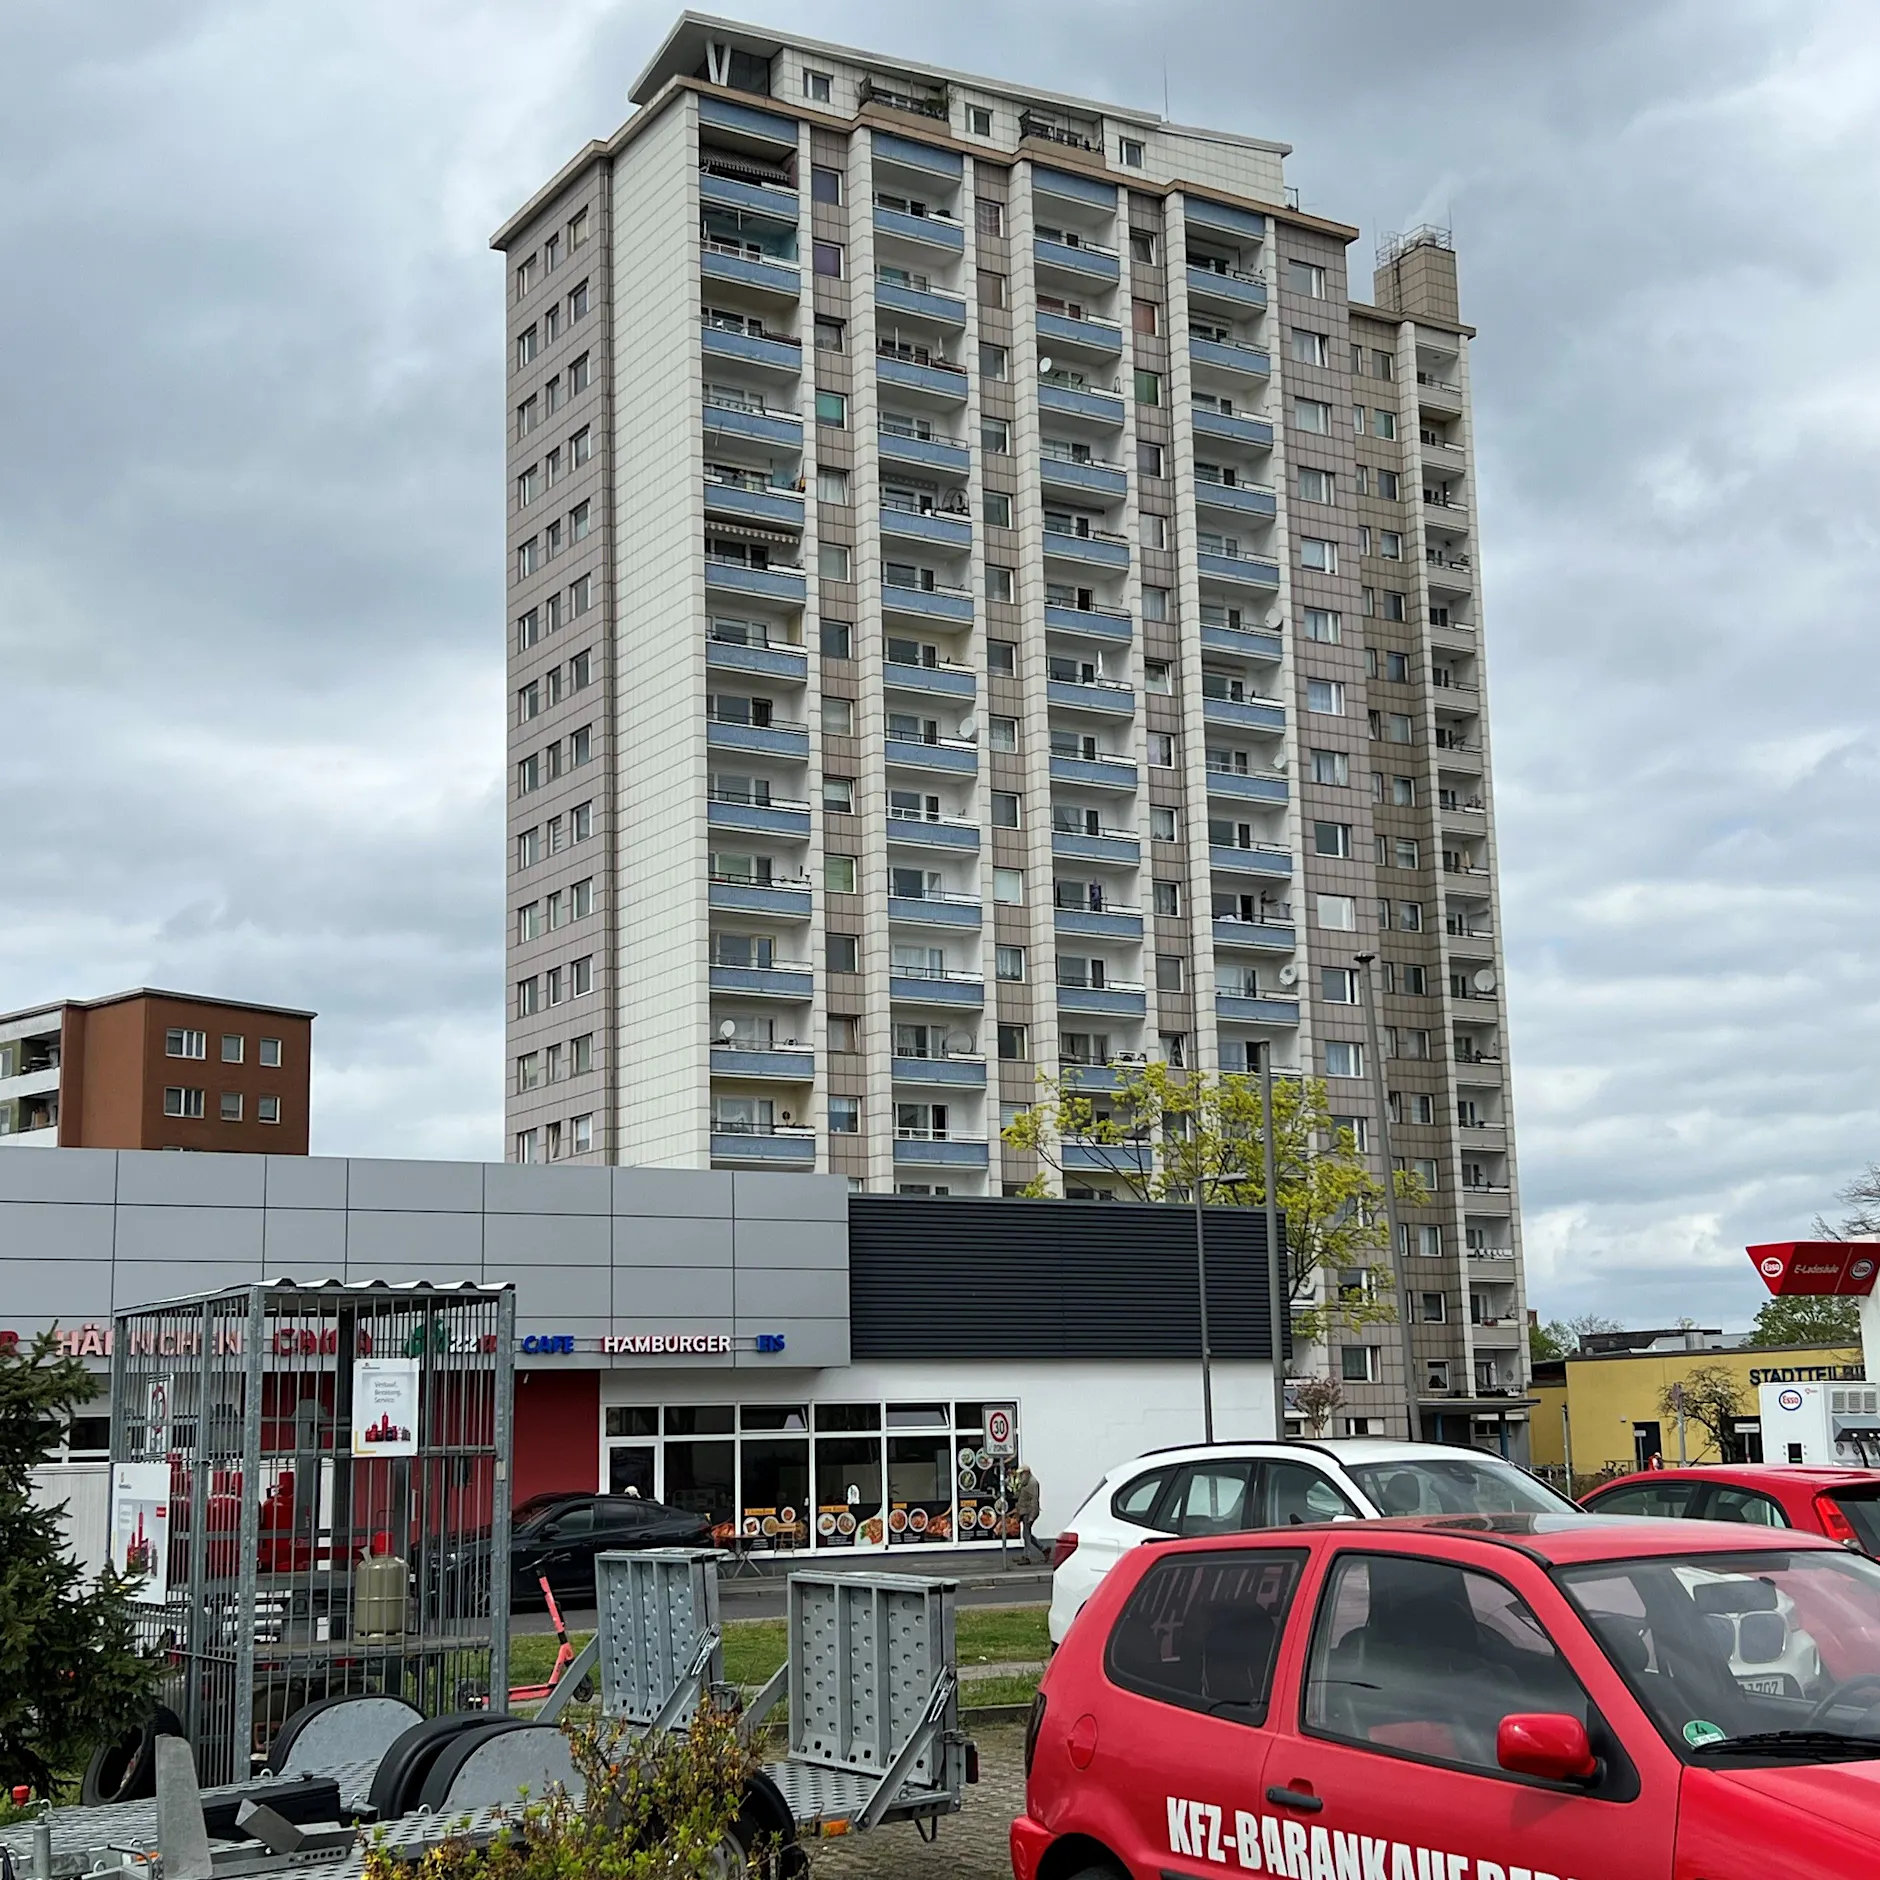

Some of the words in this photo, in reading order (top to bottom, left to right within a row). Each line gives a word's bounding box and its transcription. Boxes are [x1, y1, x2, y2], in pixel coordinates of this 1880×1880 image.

[1764, 1262, 1780, 1272] Esso
[523, 1335, 574, 1354] CAFE
[602, 1335, 731, 1353] HAMBURGER
[757, 1334, 785, 1353] EIS
[1782, 1395, 1799, 1405] Esso
[993, 1420, 1005, 1435] 30
[993, 1444, 1008, 1453] ZONE
[1695, 1723, 1708, 1735] 4
